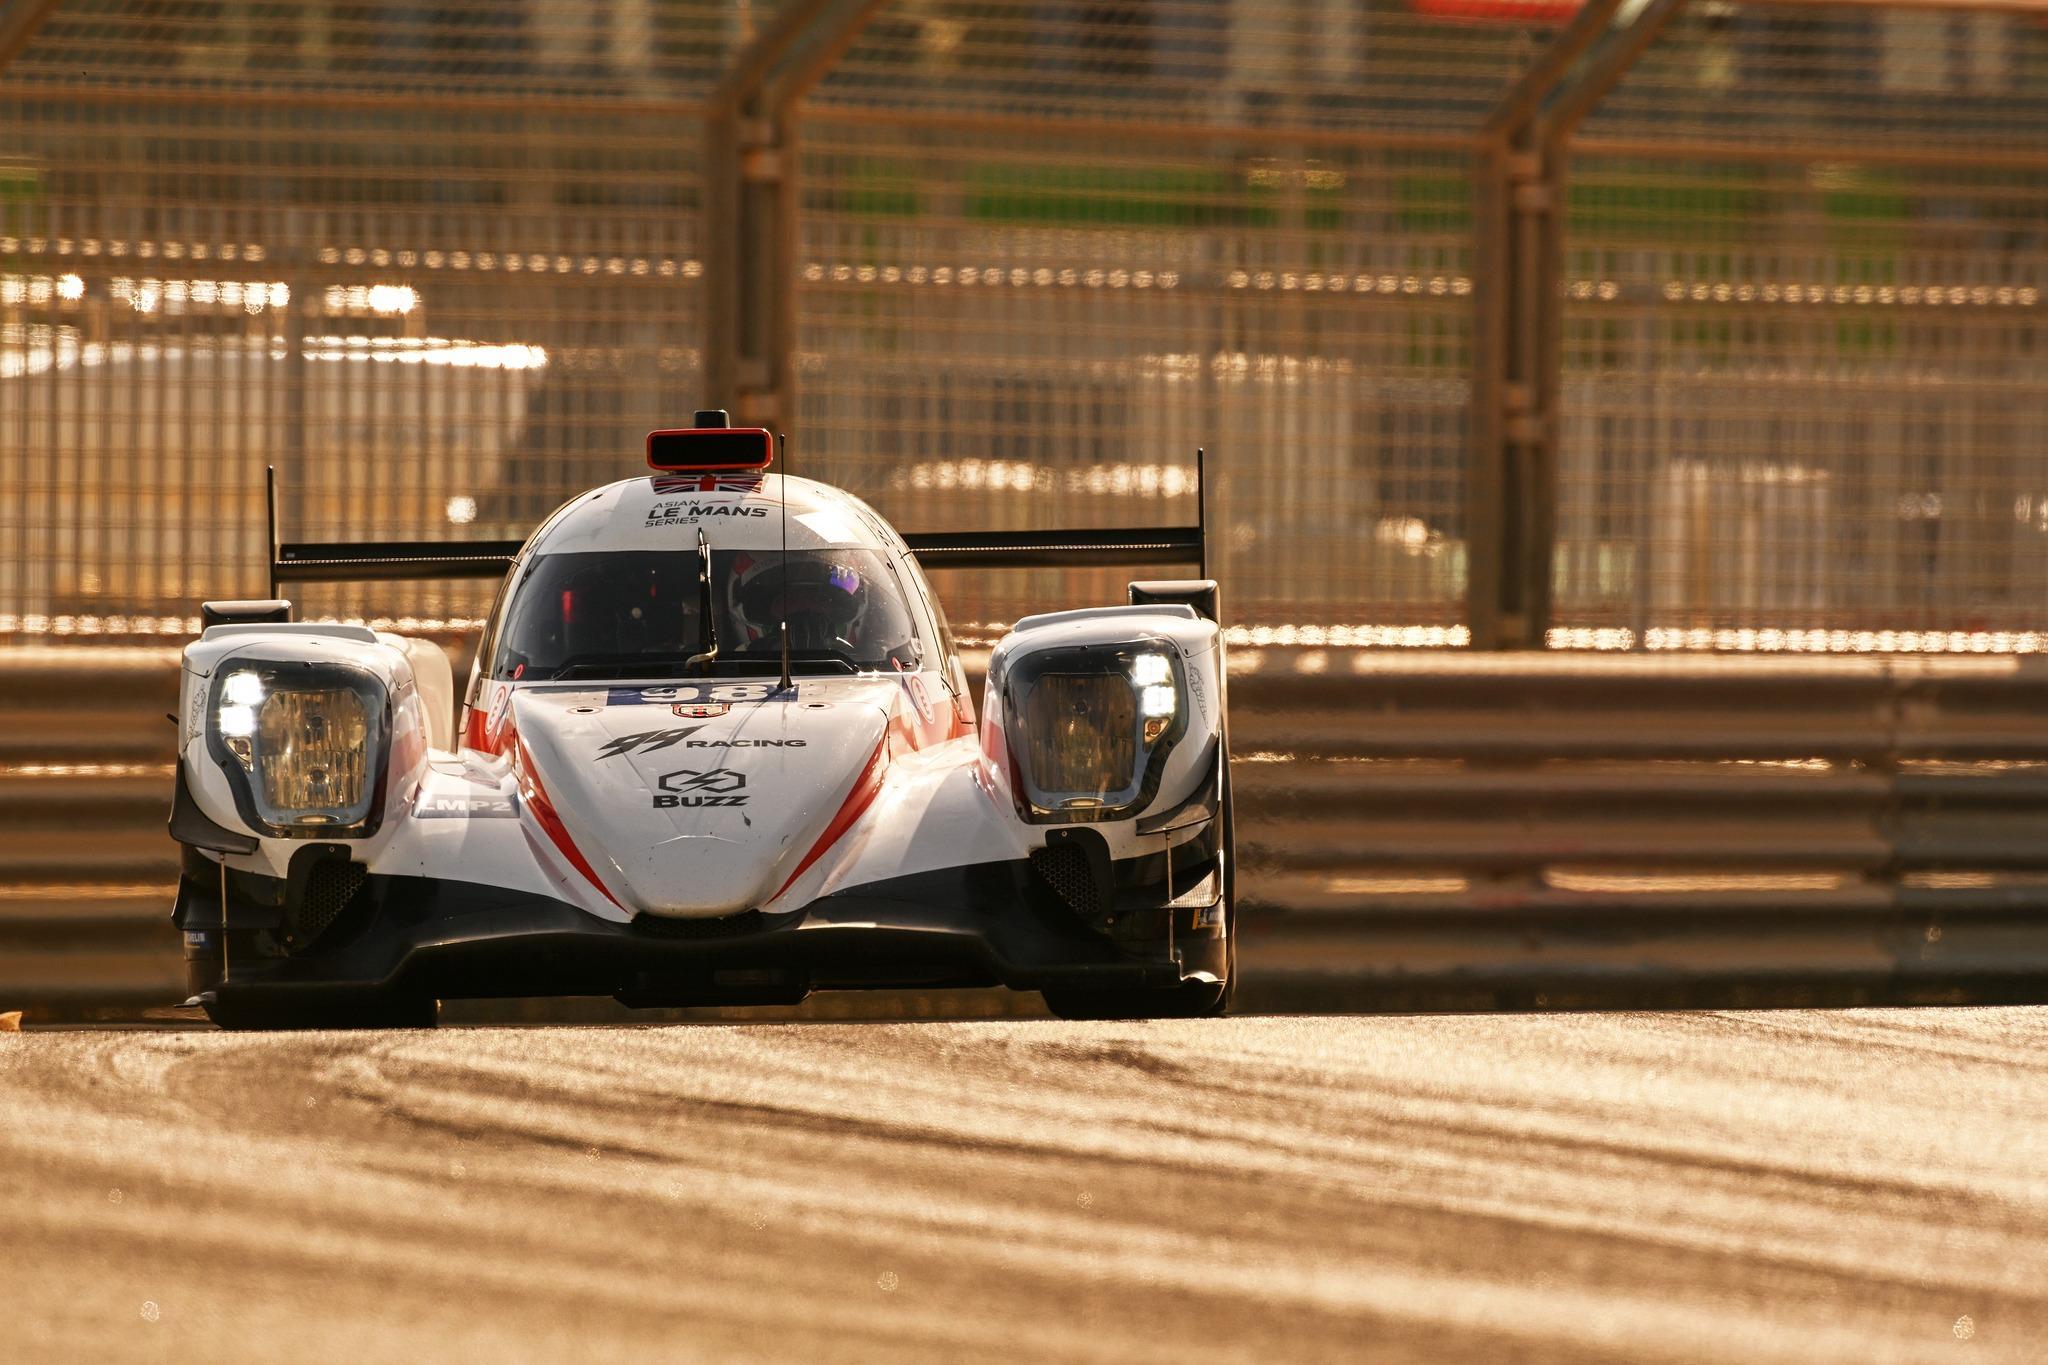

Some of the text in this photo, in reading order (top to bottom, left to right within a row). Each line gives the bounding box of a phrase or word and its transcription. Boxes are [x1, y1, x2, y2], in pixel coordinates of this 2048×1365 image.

[653, 500, 700, 509] ASIAN
[648, 506, 768, 519] LE MANS
[644, 516, 699, 528] SERIES
[640, 685, 768, 703] 98
[686, 740, 807, 749] RACING
